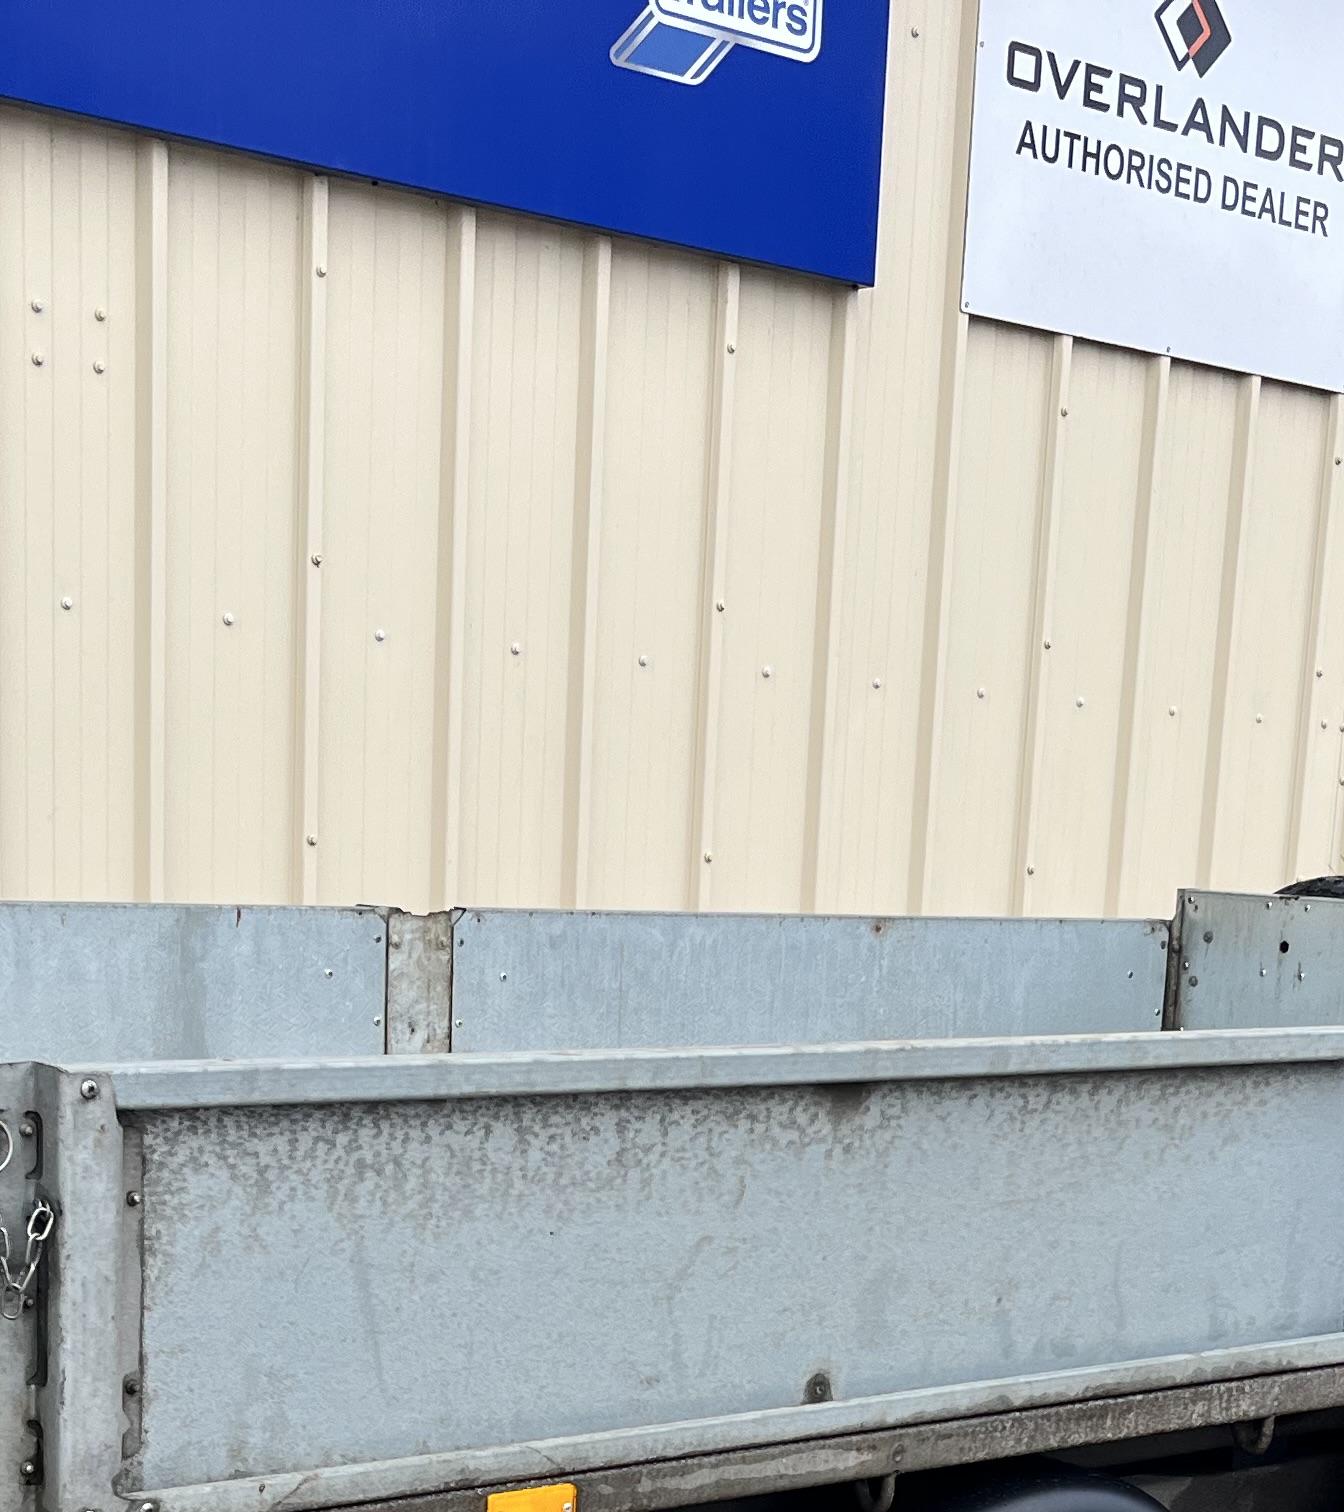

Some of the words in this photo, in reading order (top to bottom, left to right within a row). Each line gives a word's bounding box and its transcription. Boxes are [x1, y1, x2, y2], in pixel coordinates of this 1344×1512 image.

[1006, 40, 1344, 183] OVERLANDER
[1015, 120, 1212, 204] AUTHORISED
[1220, 175, 1329, 237] DEALER
